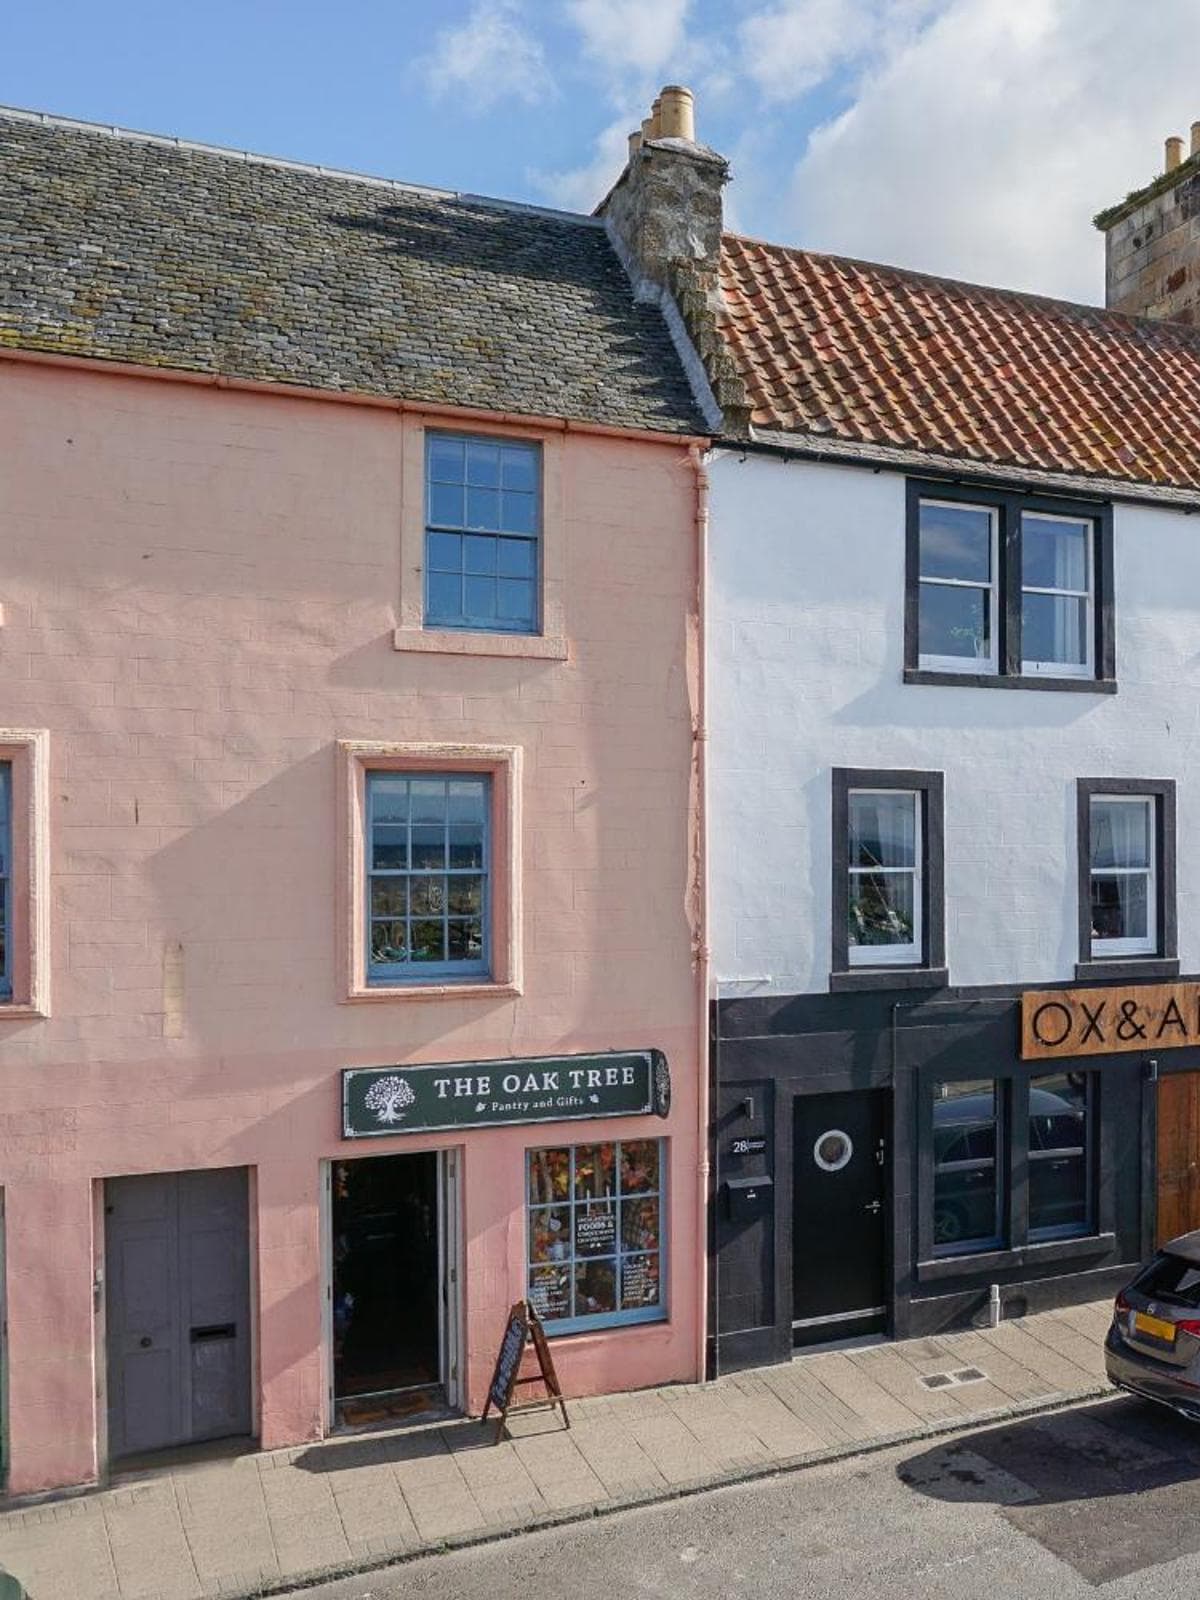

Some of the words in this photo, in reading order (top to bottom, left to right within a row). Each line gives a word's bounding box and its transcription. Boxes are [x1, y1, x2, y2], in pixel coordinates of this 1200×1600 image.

[434, 1076, 491, 1098] THE
[502, 1072, 559, 1093] OAK
[569, 1067, 635, 1088] TREE
[492, 1101, 529, 1112] Pantry
[533, 1098, 553, 1109] and
[556, 1095, 584, 1107] Gifts
[733, 1141, 747, 1153] 28
